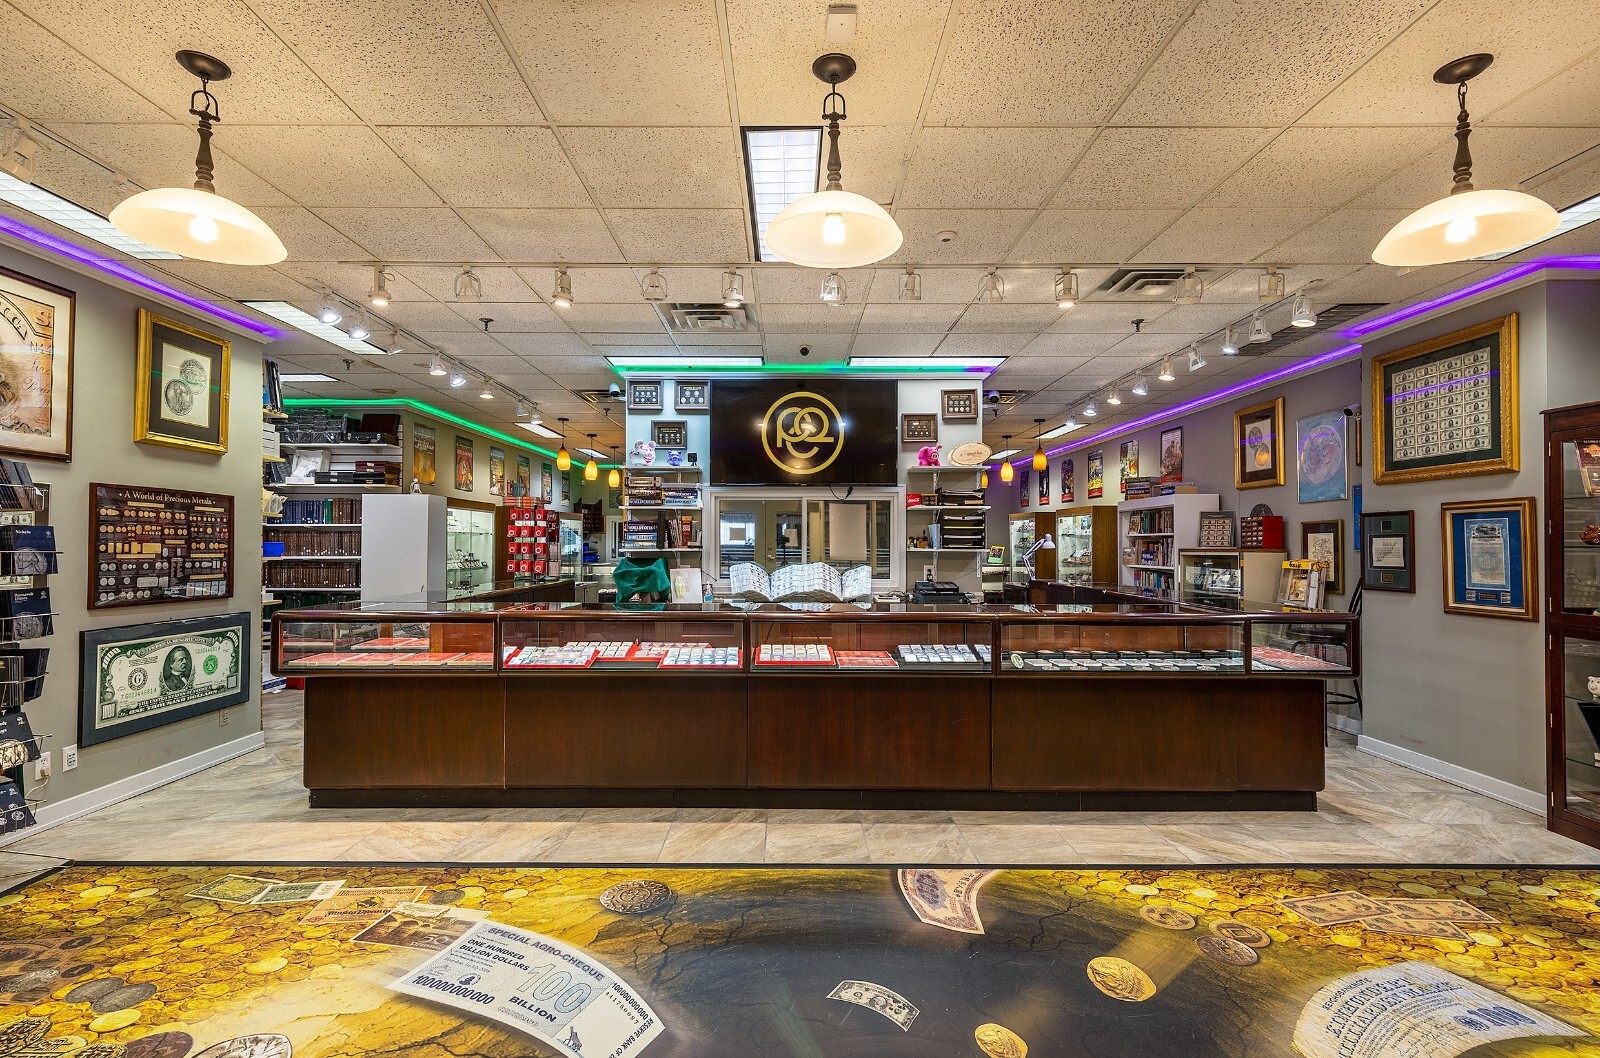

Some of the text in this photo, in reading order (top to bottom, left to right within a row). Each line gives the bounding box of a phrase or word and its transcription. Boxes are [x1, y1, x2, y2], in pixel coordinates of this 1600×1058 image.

[124, 490, 132, 498] A
[133, 490, 155, 500] World
[156, 492, 164, 500] of
[164, 494, 191, 504] Precious
[134, 674, 141, 685] G
[422, 934, 449, 944] 50
[467, 938, 485, 948] ONE
[486, 944, 525, 960] HUNDRED
[460, 944, 493, 958] BILLION
[492, 952, 530, 971] DOLLARS
[488, 927, 530, 945] SPECIAL
[531, 940, 606, 982] AGRO-CHEQUE
[516, 963, 592, 1014] 100
[508, 996, 557, 1023] BILLION
[634, 1017, 654, 1039] RESERVE
[622, 1035, 636, 1051] BANK
